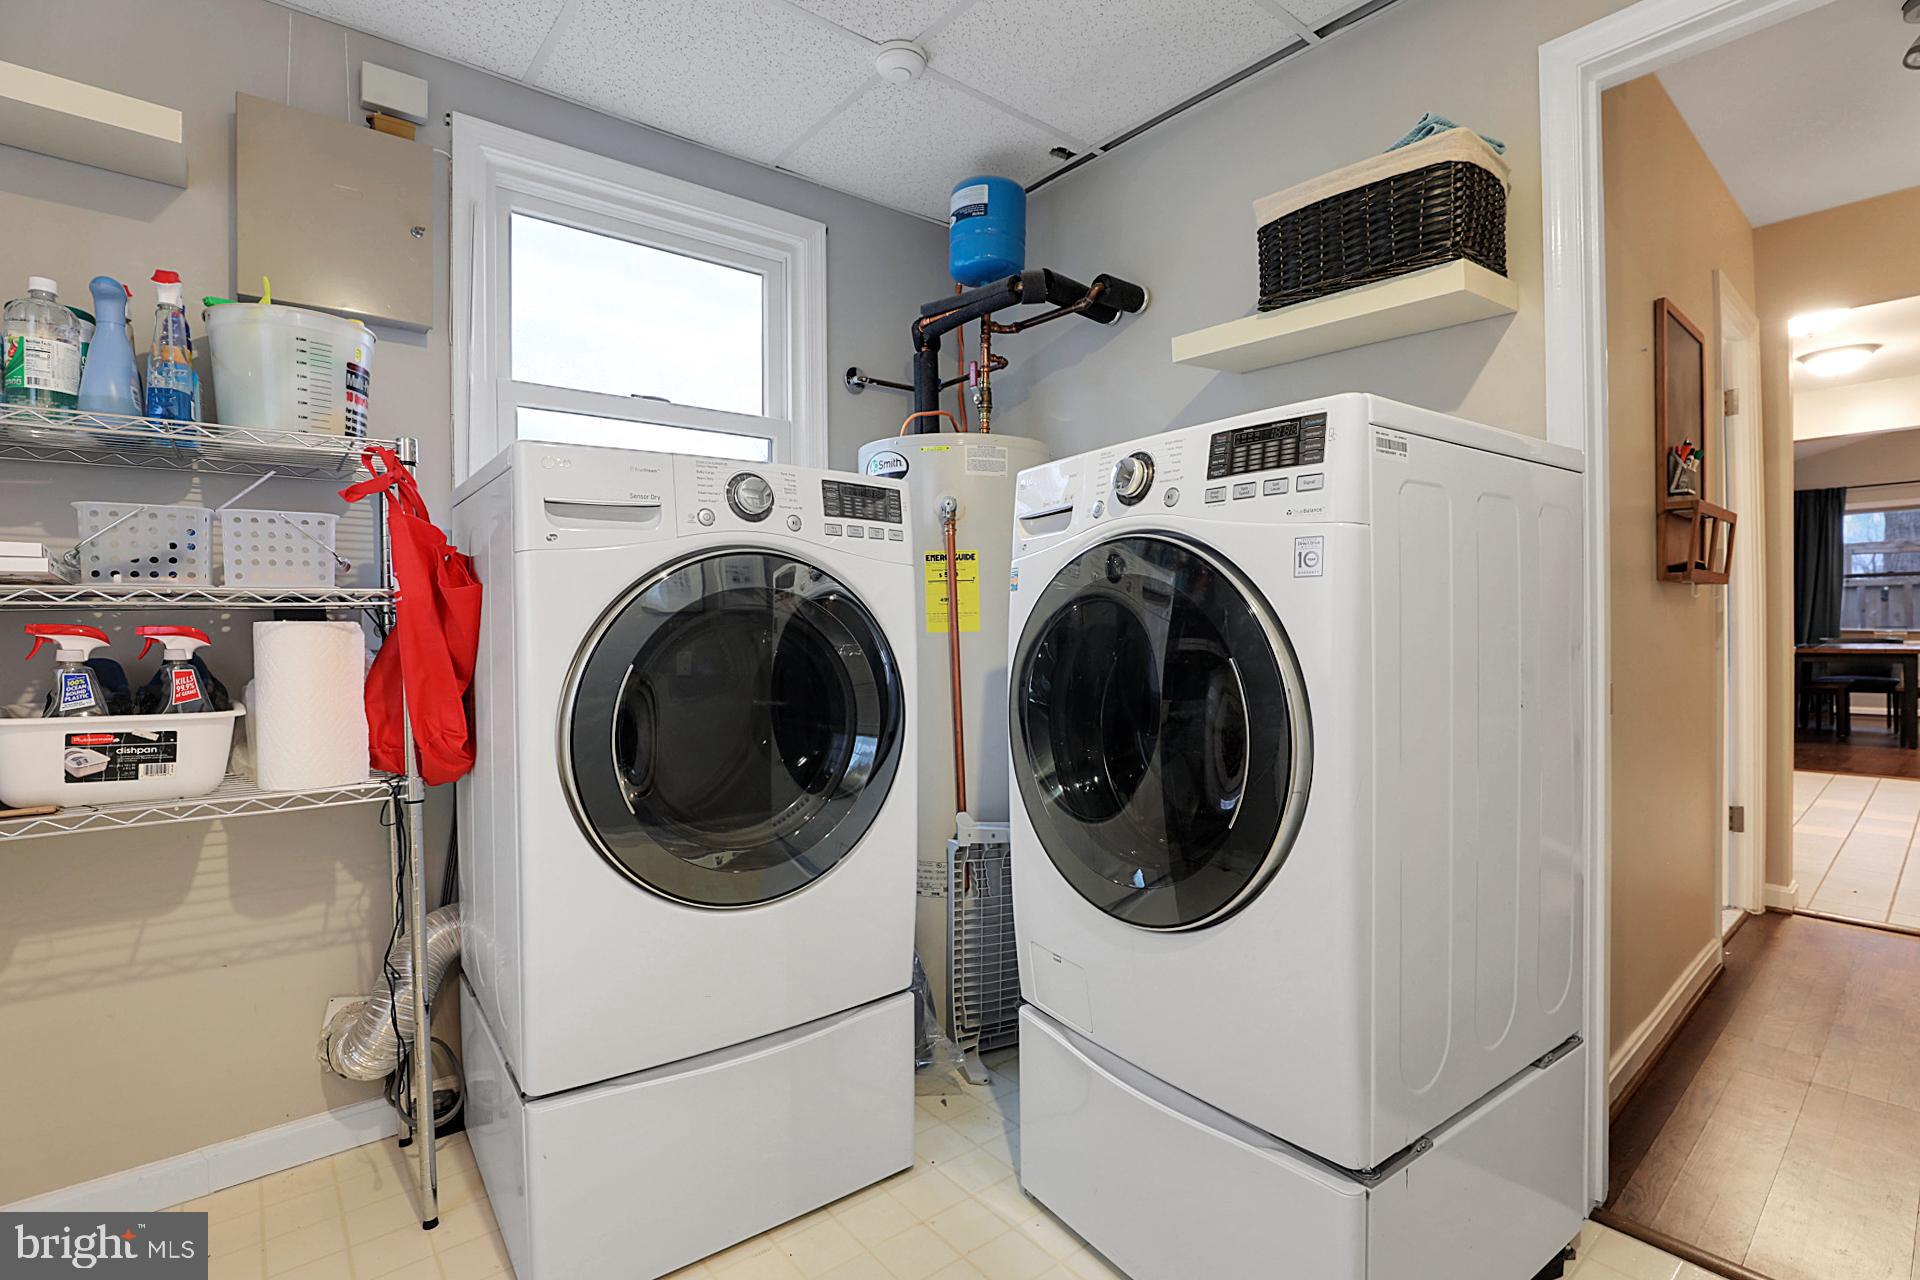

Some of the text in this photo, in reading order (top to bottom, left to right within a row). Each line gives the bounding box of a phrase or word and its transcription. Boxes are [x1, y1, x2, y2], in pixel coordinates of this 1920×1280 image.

[878, 458, 902, 470] Smith
[176, 675, 194, 685] KILLS
[65, 693, 90, 702] PLASTIC
